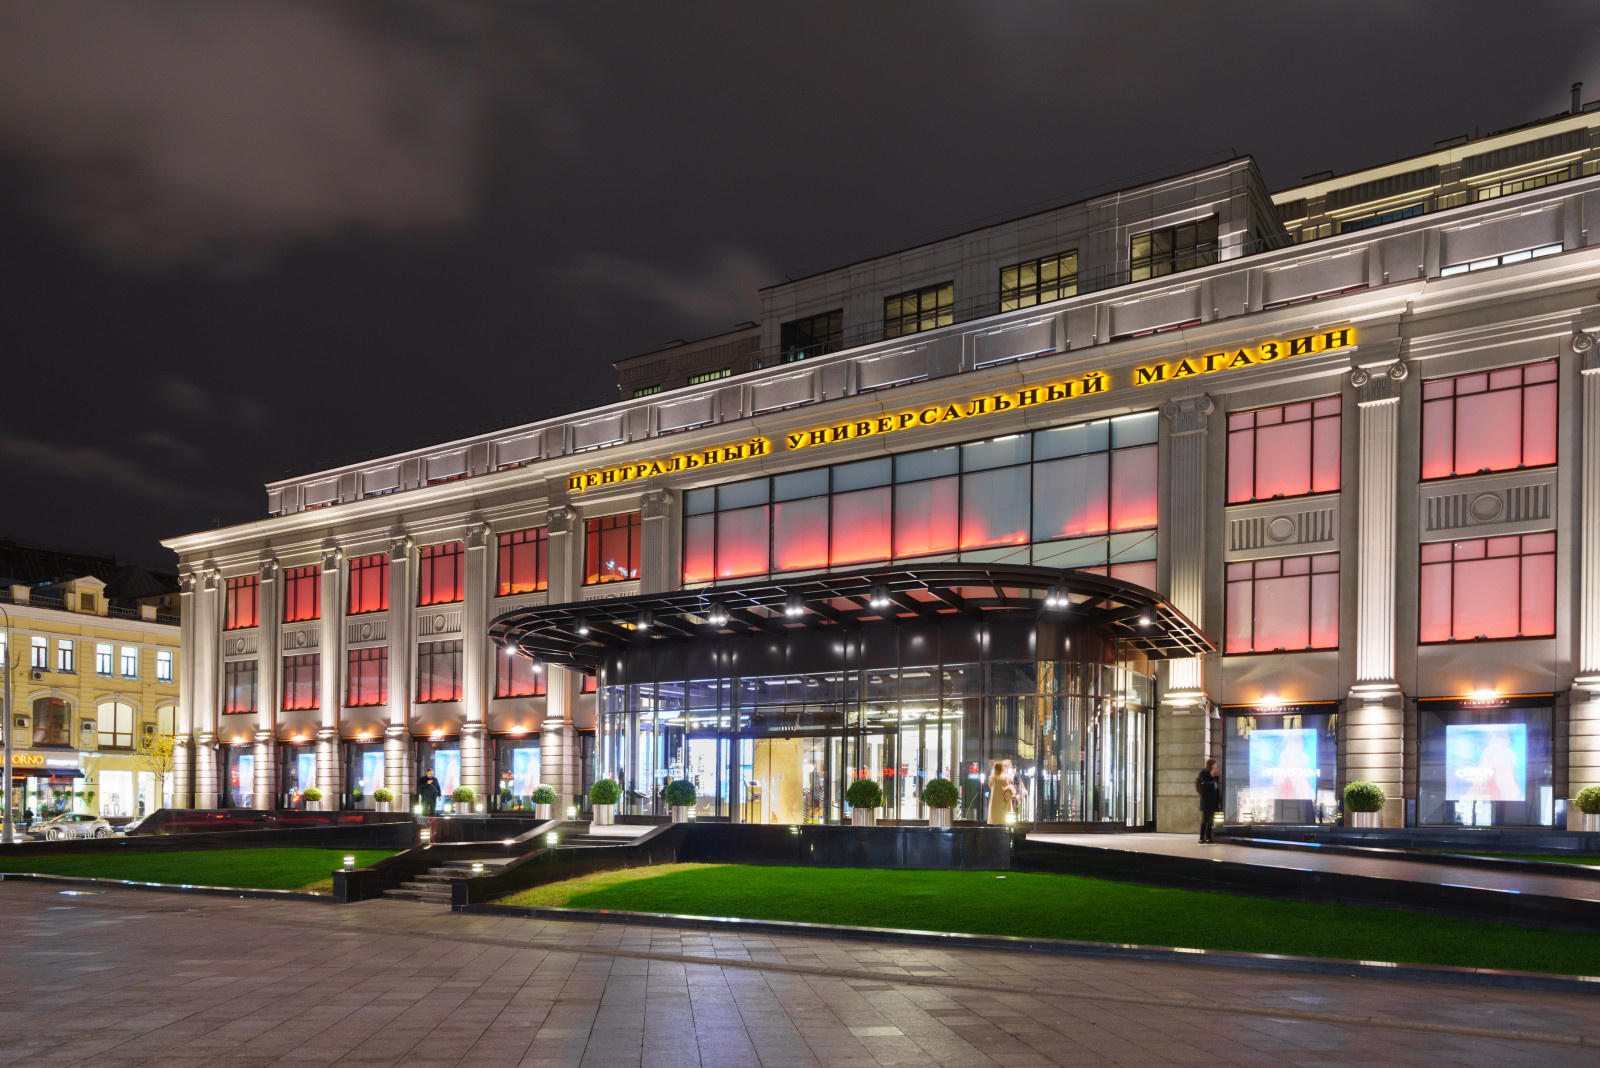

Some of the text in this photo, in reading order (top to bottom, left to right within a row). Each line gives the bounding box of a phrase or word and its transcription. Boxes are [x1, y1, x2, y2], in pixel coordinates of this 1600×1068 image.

[569, 328, 1352, 491] ЦЕНТРАЛЬНЫЙ УНИВЕРСАЛЬНЫЙ МАГАЗИН
